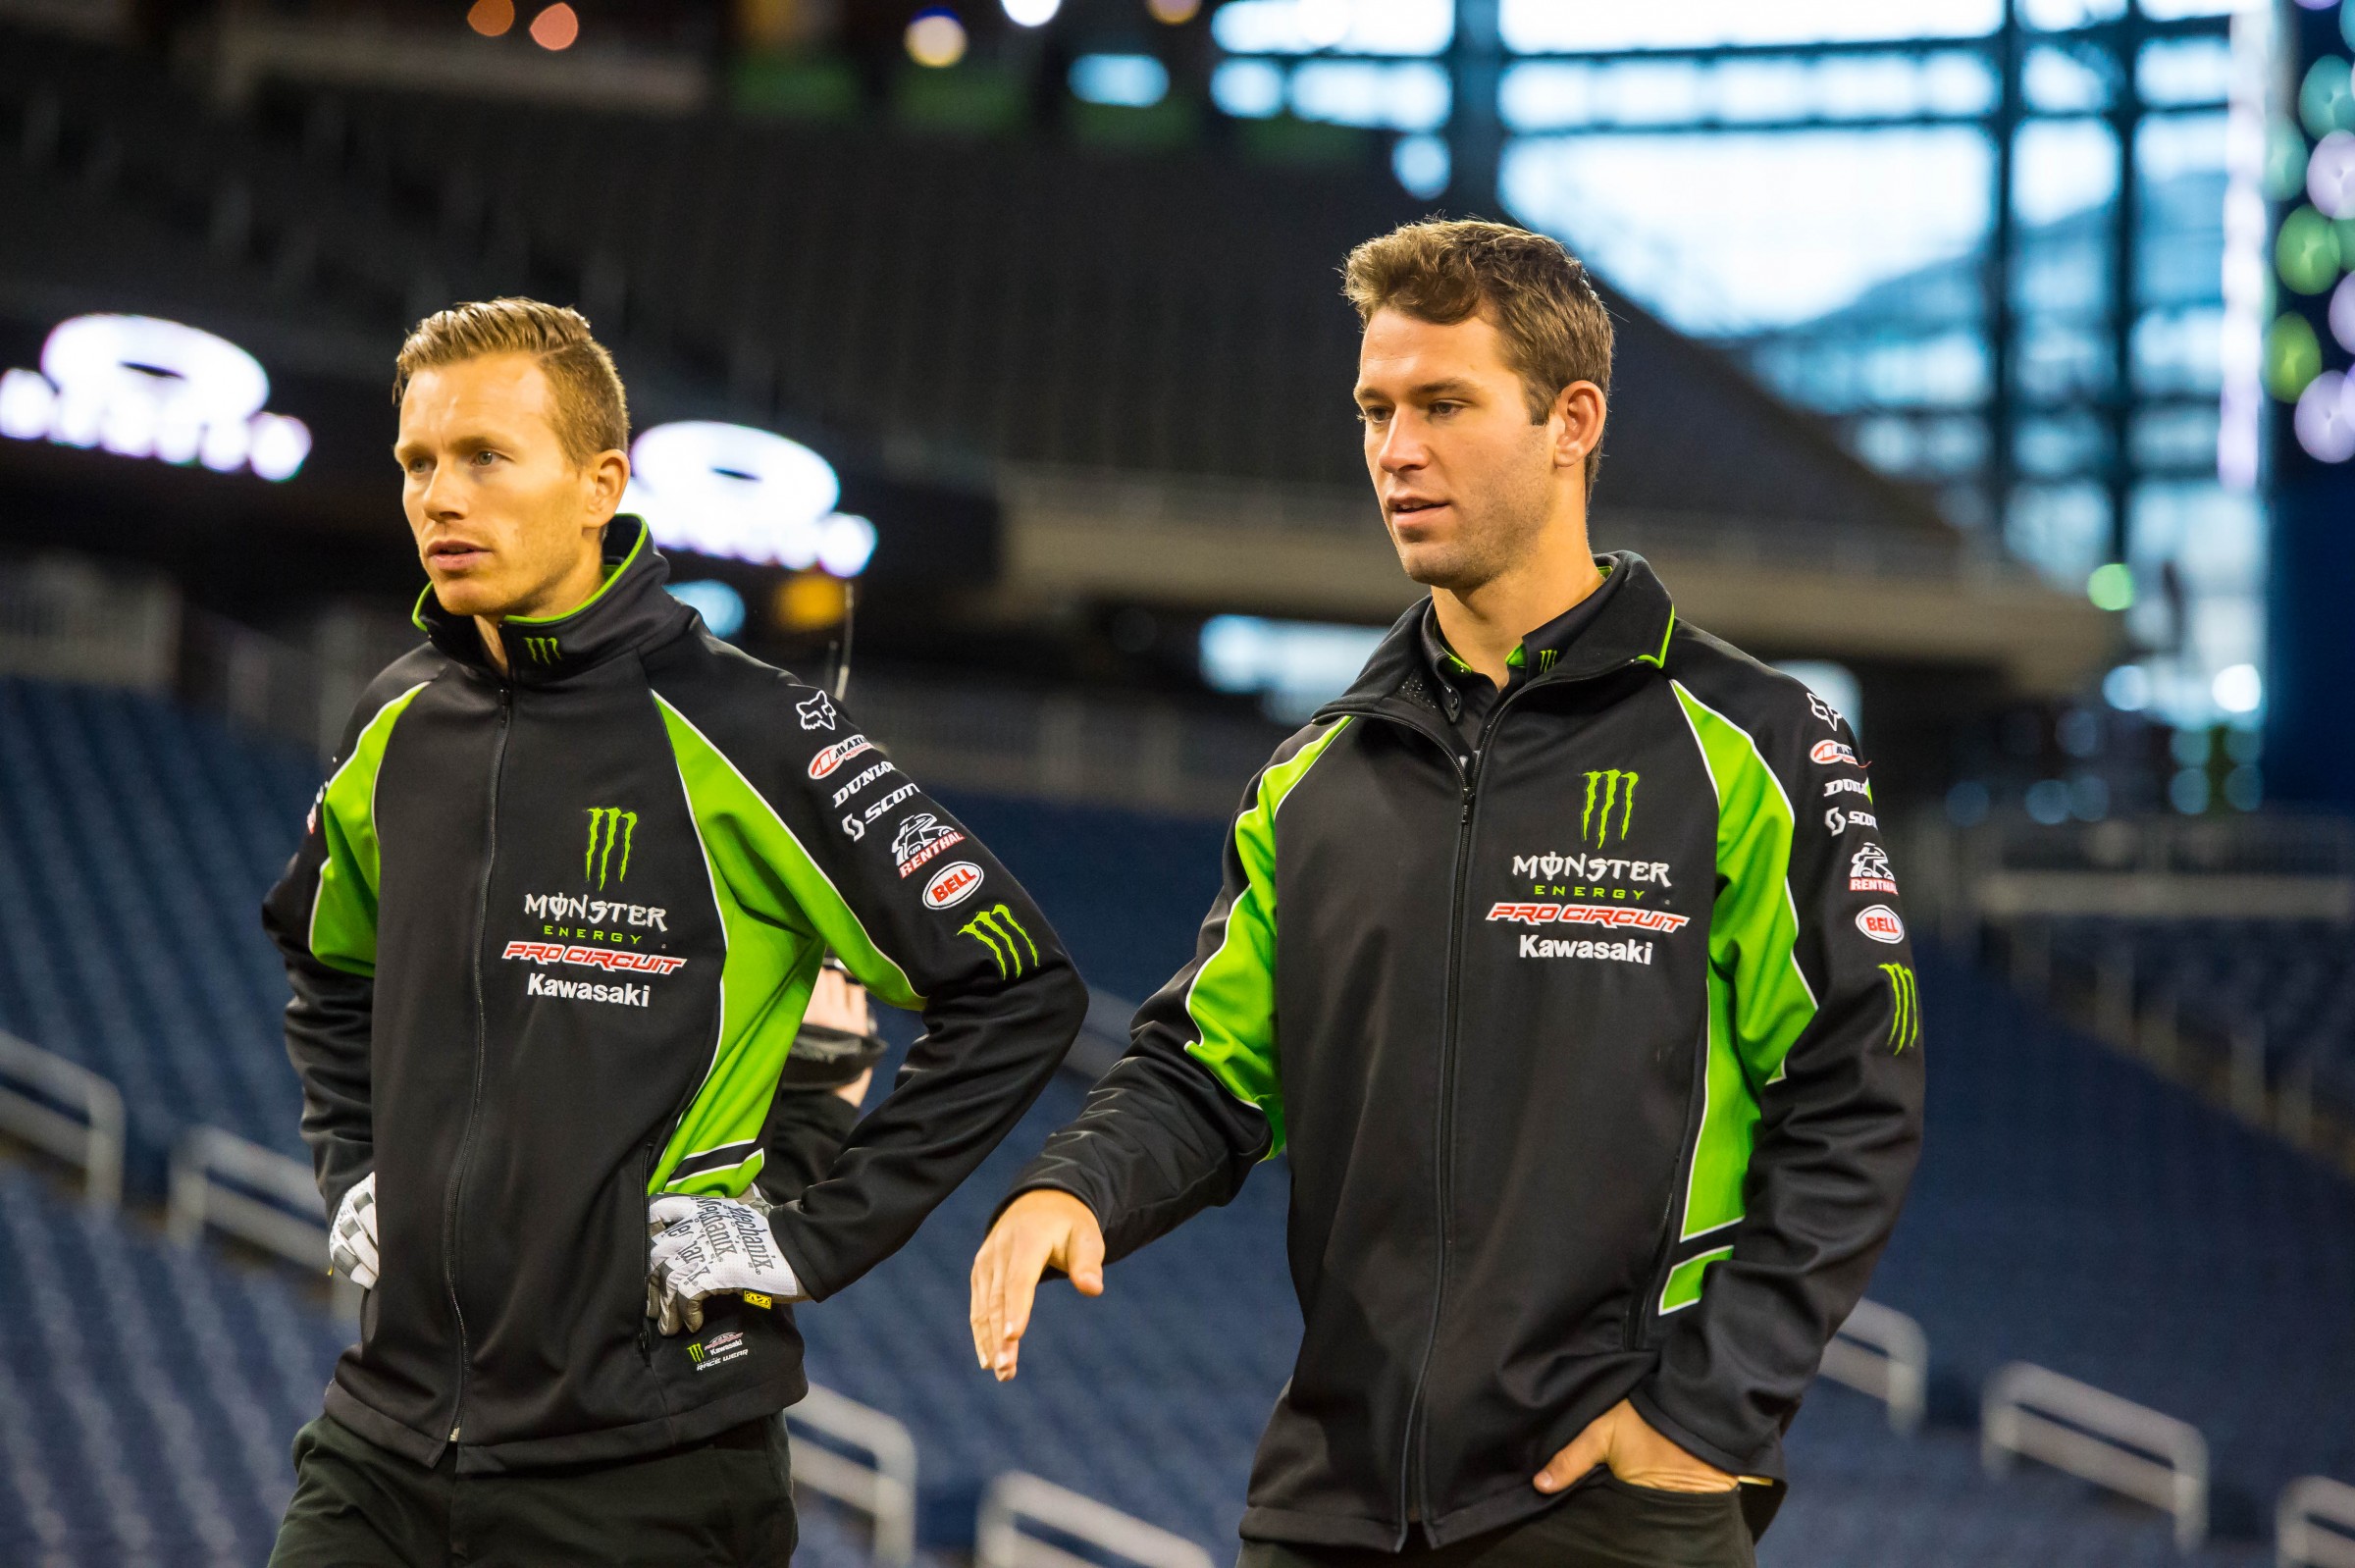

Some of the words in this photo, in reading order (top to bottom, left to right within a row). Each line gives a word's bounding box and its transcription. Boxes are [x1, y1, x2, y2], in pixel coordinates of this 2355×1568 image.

[835, 736, 868, 759] MAXI
[833, 761, 895, 809] DUNLO
[899, 831, 966, 879] RENTHAL
[1512, 851, 1672, 888] MONSTER
[931, 868, 977, 903] BELL
[1534, 885, 1645, 901] ENERGY
[524, 892, 668, 932] MONSTER
[1486, 903, 1561, 925] PRO
[1559, 904, 1690, 933] CIRCUIT
[1866, 916, 1898, 933] BELL
[544, 925, 643, 945] ENERGY
[1519, 935, 1653, 965] Kawasaki
[501, 941, 564, 966] PRO
[564, 946, 687, 974] CIRCUIT
[527, 972, 651, 1008] Kawasaki
[709, 1339, 743, 1356] Kawasaki
